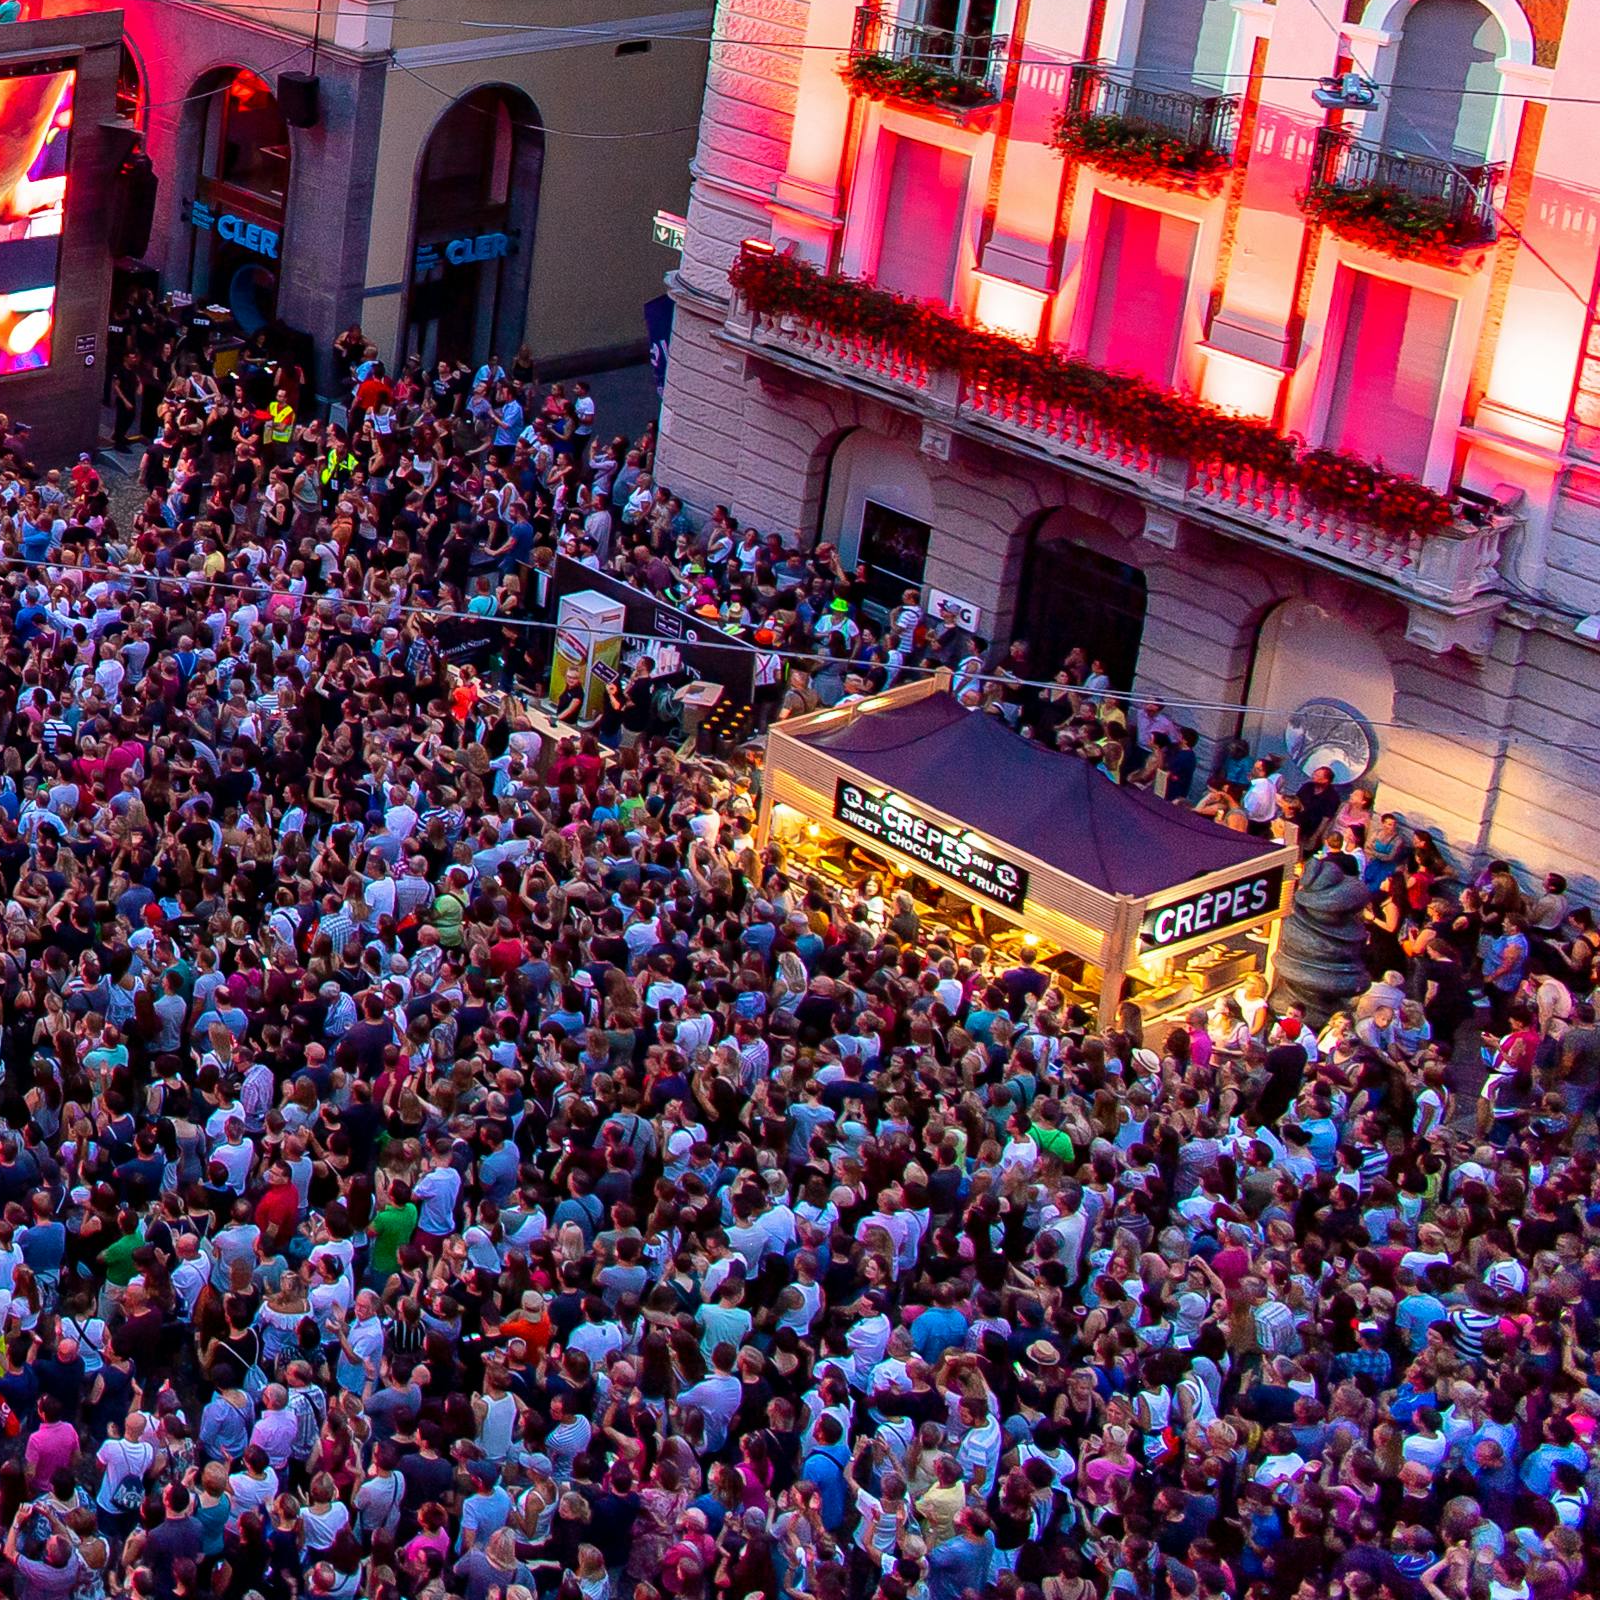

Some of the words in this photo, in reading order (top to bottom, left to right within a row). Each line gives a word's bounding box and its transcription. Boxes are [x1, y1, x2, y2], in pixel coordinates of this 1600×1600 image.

[217, 213, 278, 259] CLER
[445, 232, 509, 265] CLER
[841, 807, 882, 835] SWEET
[887, 829, 962, 877] CHOCOLATE
[968, 871, 1017, 902] FRUITY
[881, 805, 973, 865] CRÊPES
[1153, 877, 1269, 944] CRÊPES
